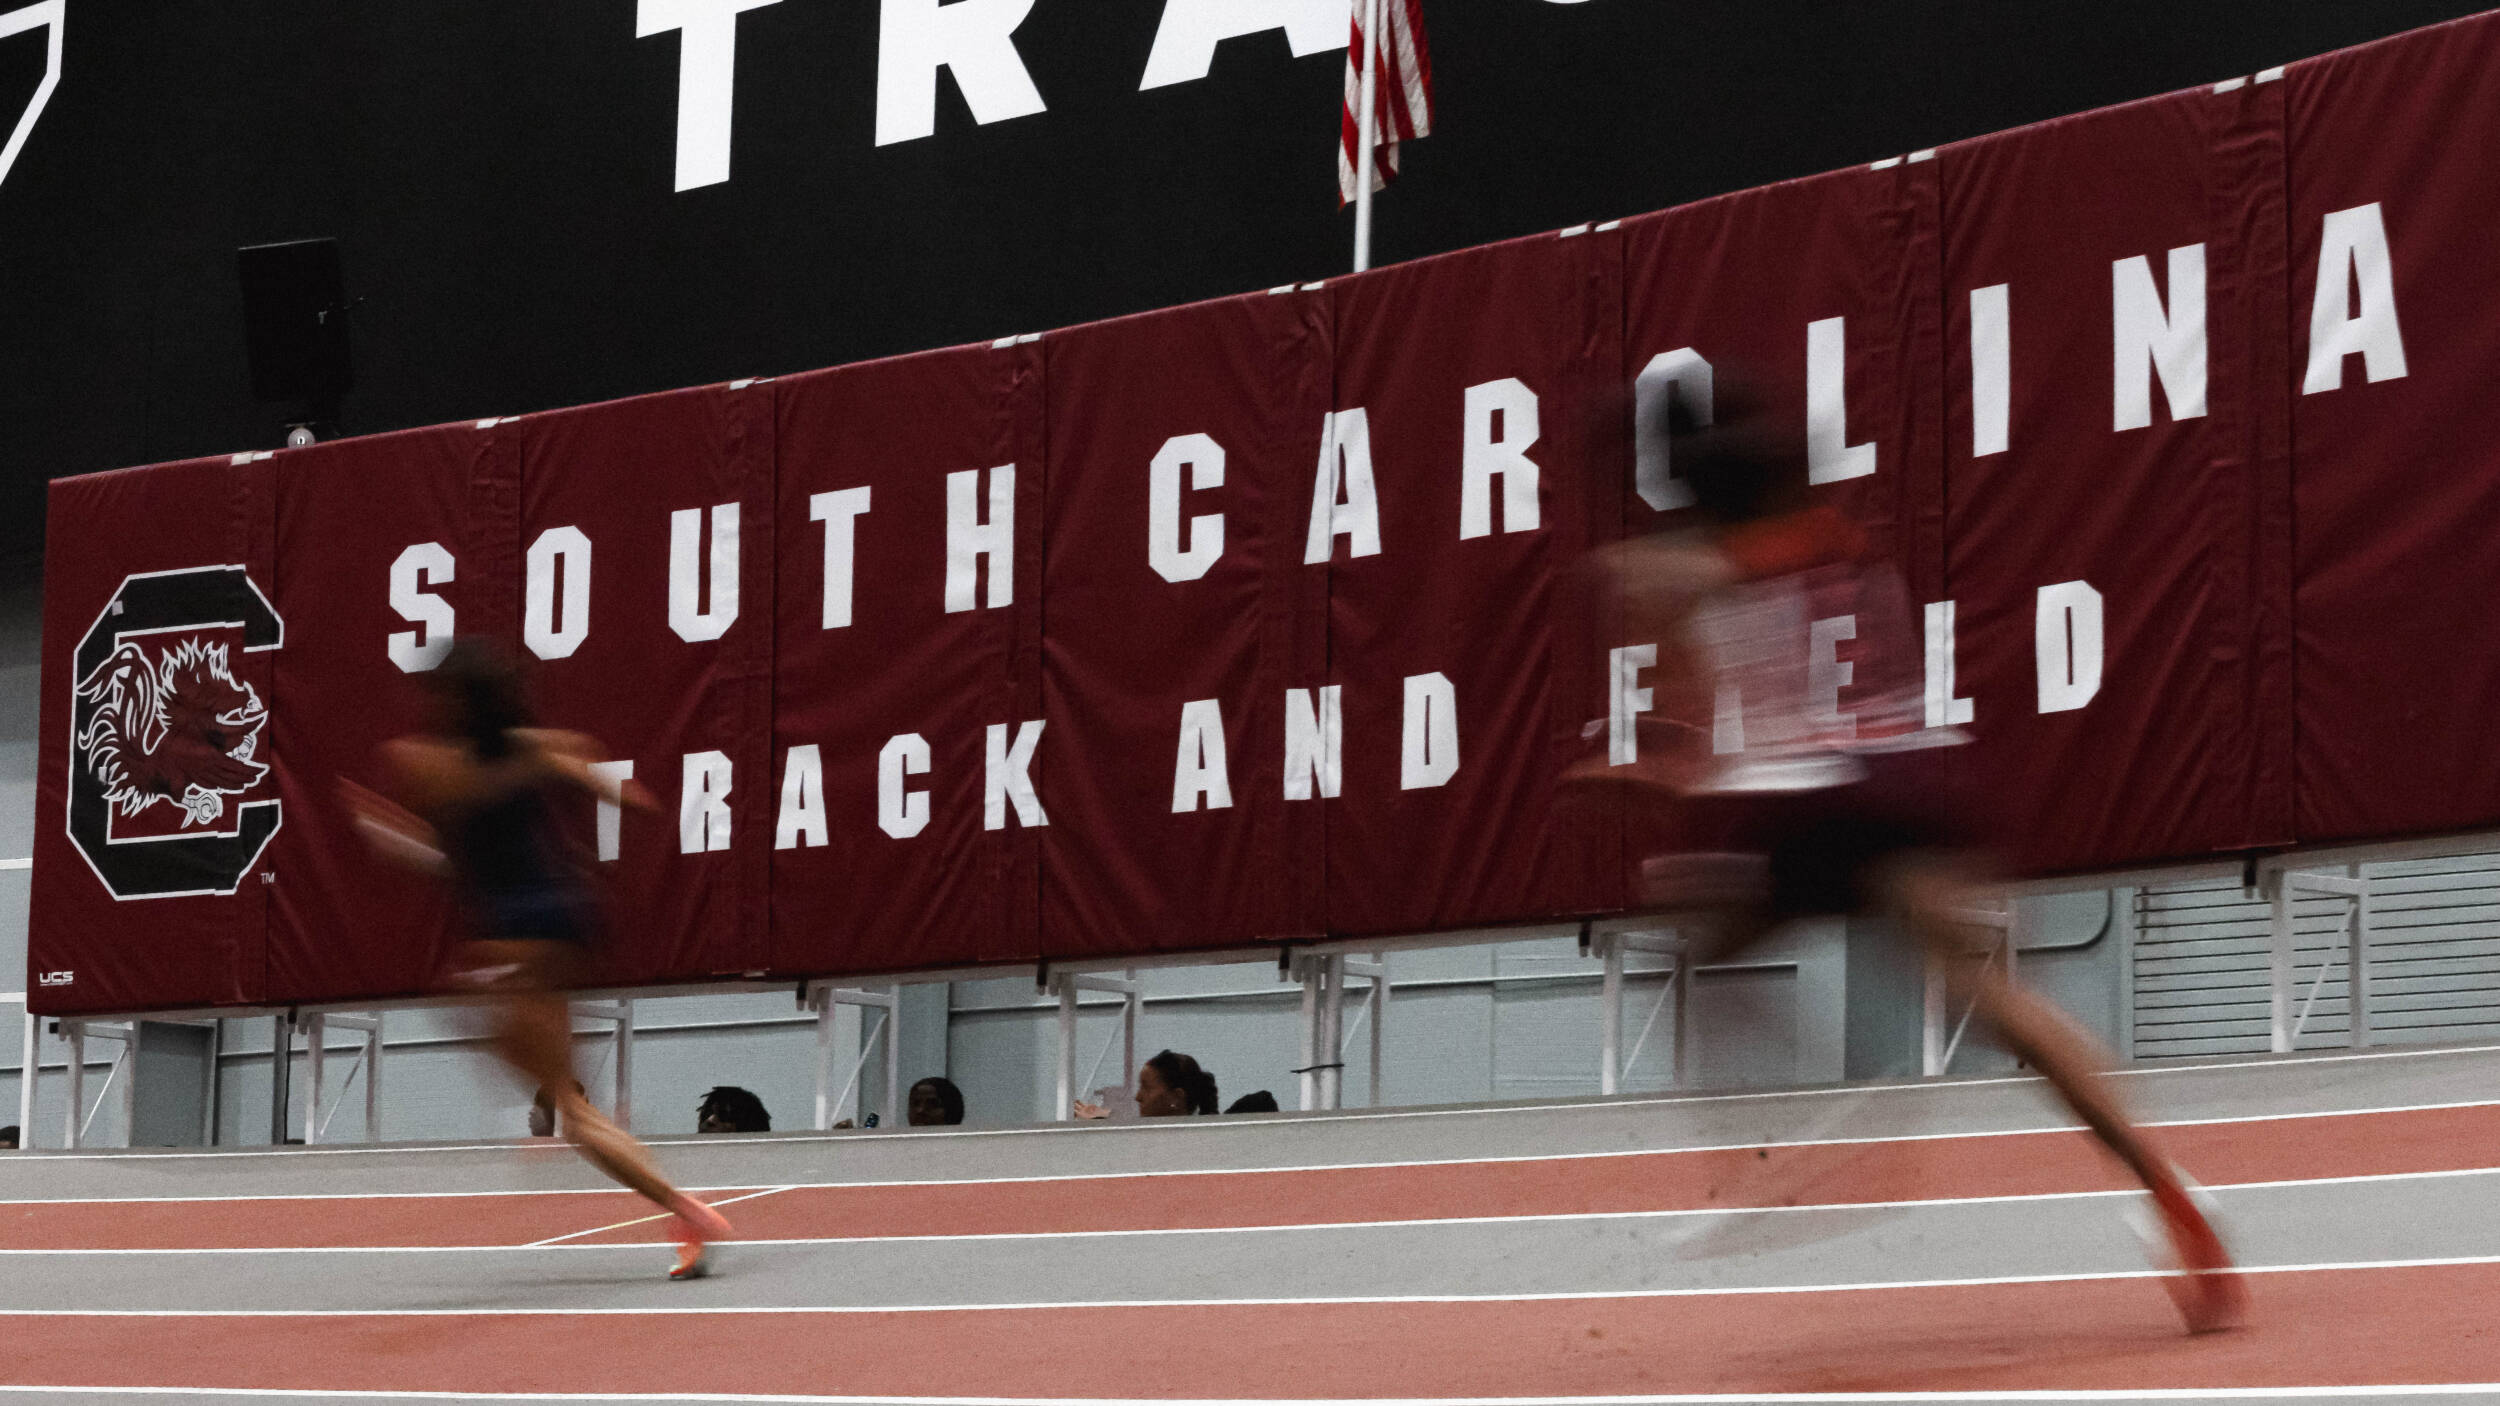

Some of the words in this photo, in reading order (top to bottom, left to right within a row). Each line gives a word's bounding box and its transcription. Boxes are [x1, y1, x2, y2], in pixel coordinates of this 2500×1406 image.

[387, 462, 1016, 674] SOUTH
[1148, 201, 2408, 584] CAROLINA
[590, 718, 1049, 863] TRACK
[1171, 671, 1460, 814] AND
[39, 970, 75, 984] UCS
